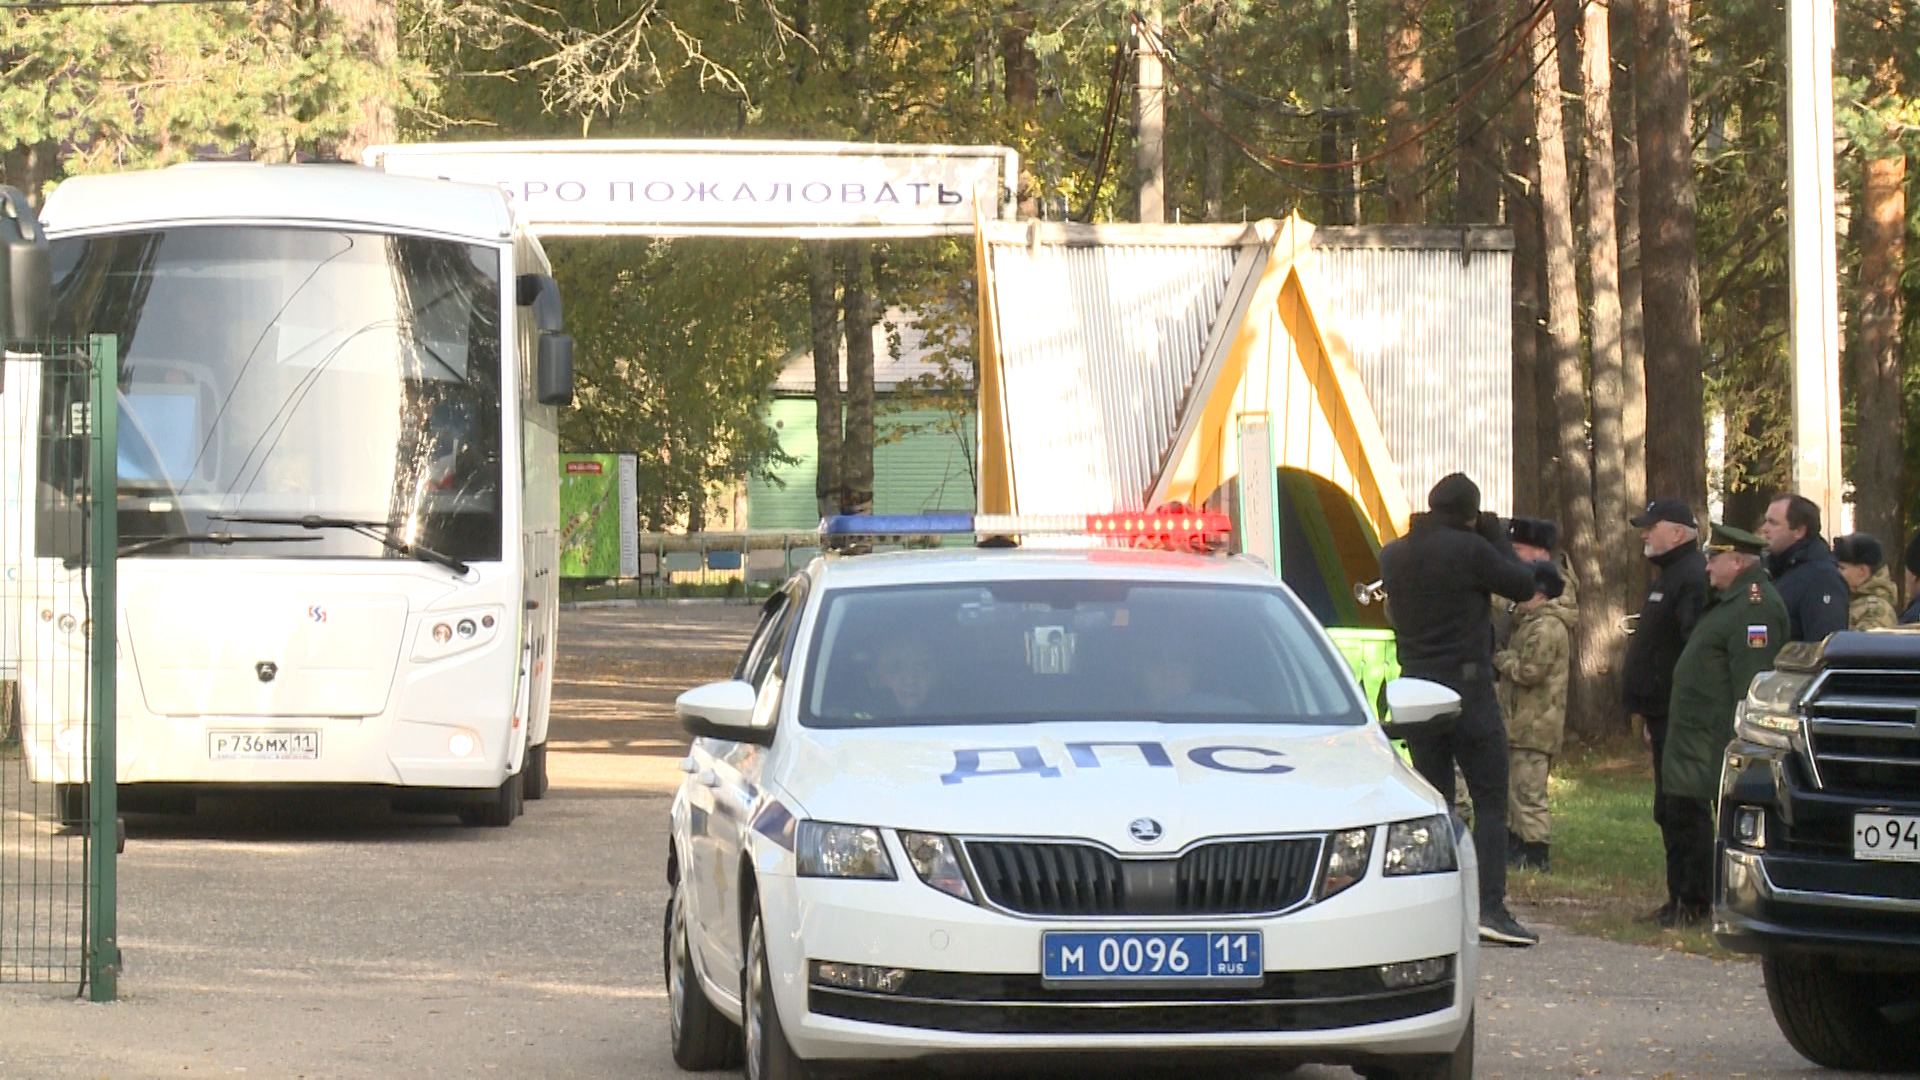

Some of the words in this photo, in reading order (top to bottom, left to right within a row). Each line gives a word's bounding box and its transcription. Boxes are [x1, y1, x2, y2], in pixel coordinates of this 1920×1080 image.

[497, 181, 586, 202] БРО
[609, 181, 963, 205] ПОЖАЛОВАТЬ
[293, 735, 311, 748] 11
[940, 741, 1295, 785] ДПС
[1098, 937, 1189, 972] 0096
[1214, 935, 1248, 962] 11
[1217, 963, 1245, 974] RUS
